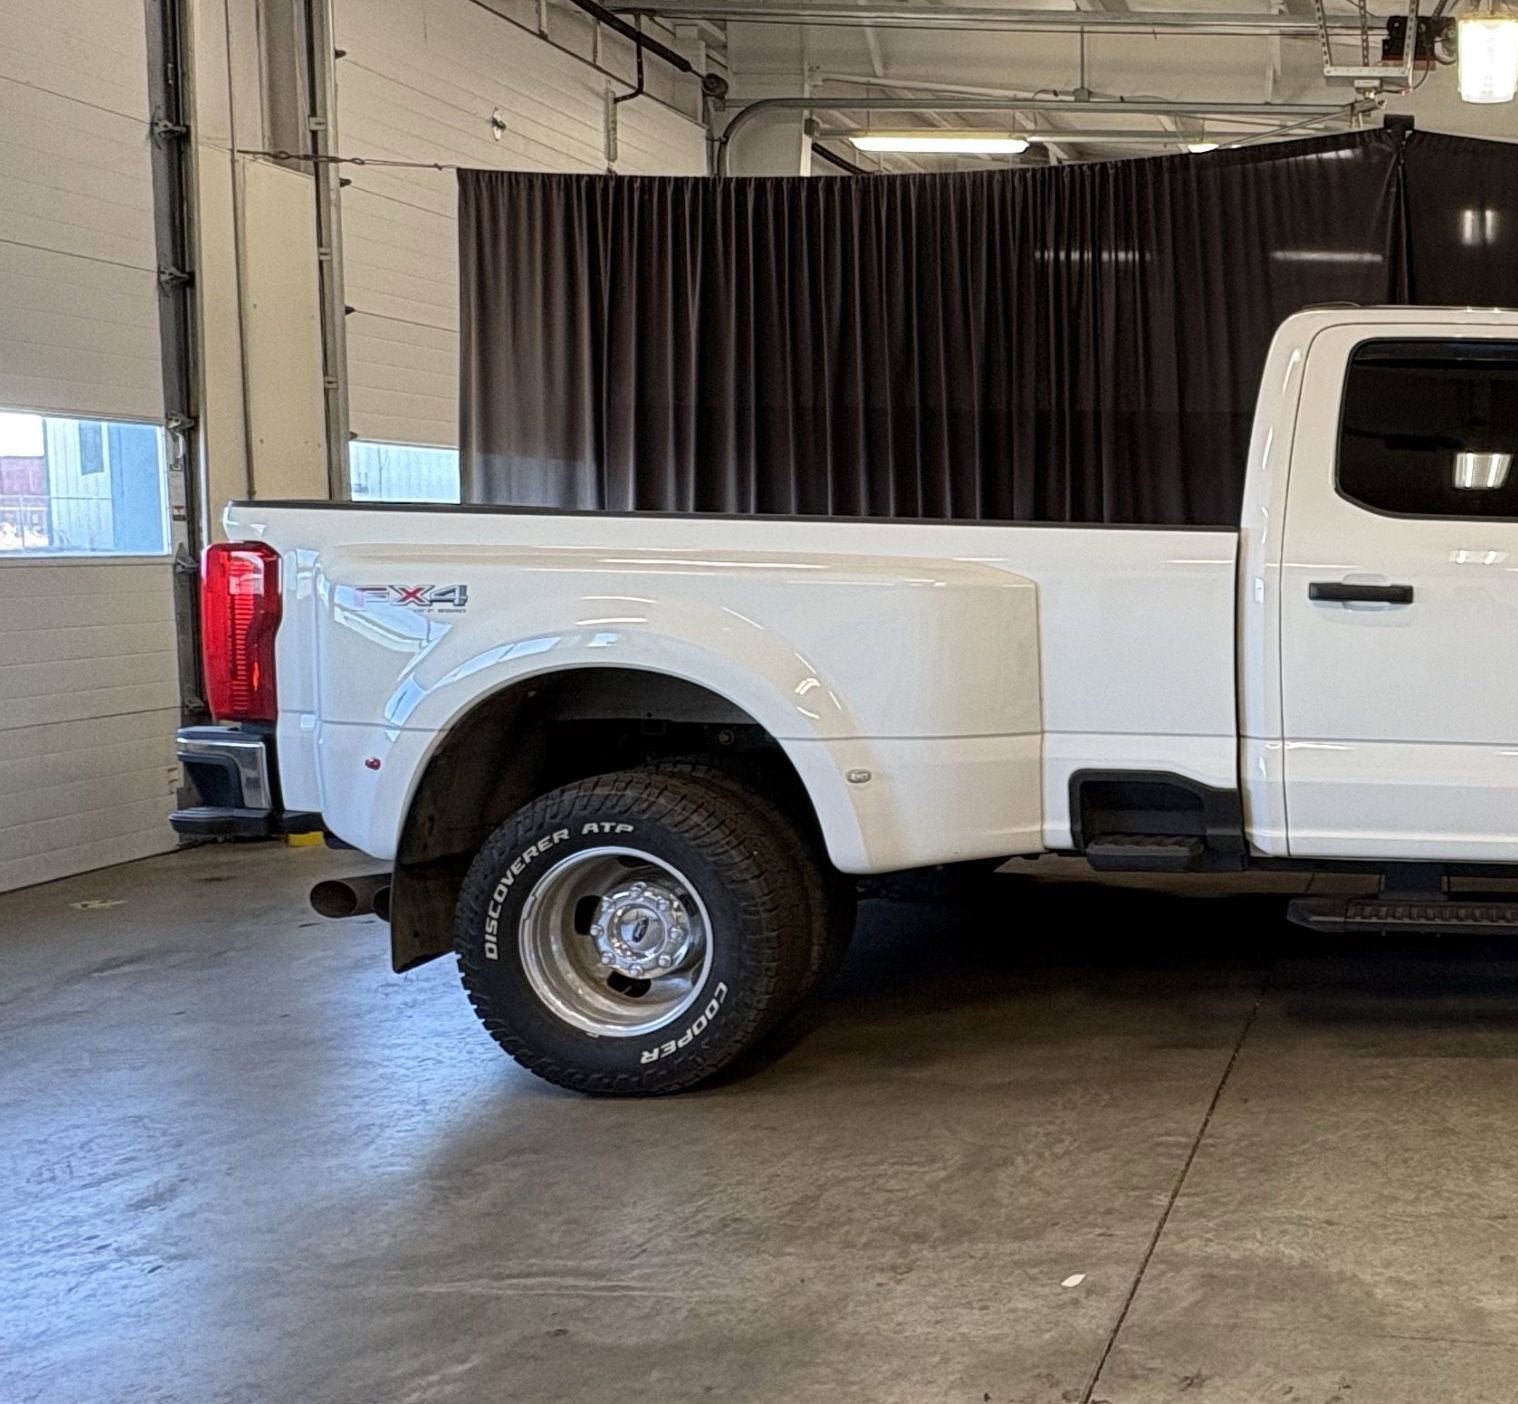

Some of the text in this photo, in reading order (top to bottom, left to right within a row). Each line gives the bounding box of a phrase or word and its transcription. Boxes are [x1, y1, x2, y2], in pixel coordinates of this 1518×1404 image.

[353, 584, 468, 611] FX4
[484, 822, 635, 961] DISCOVERER ATP
[640, 981, 729, 1065] COOPER
